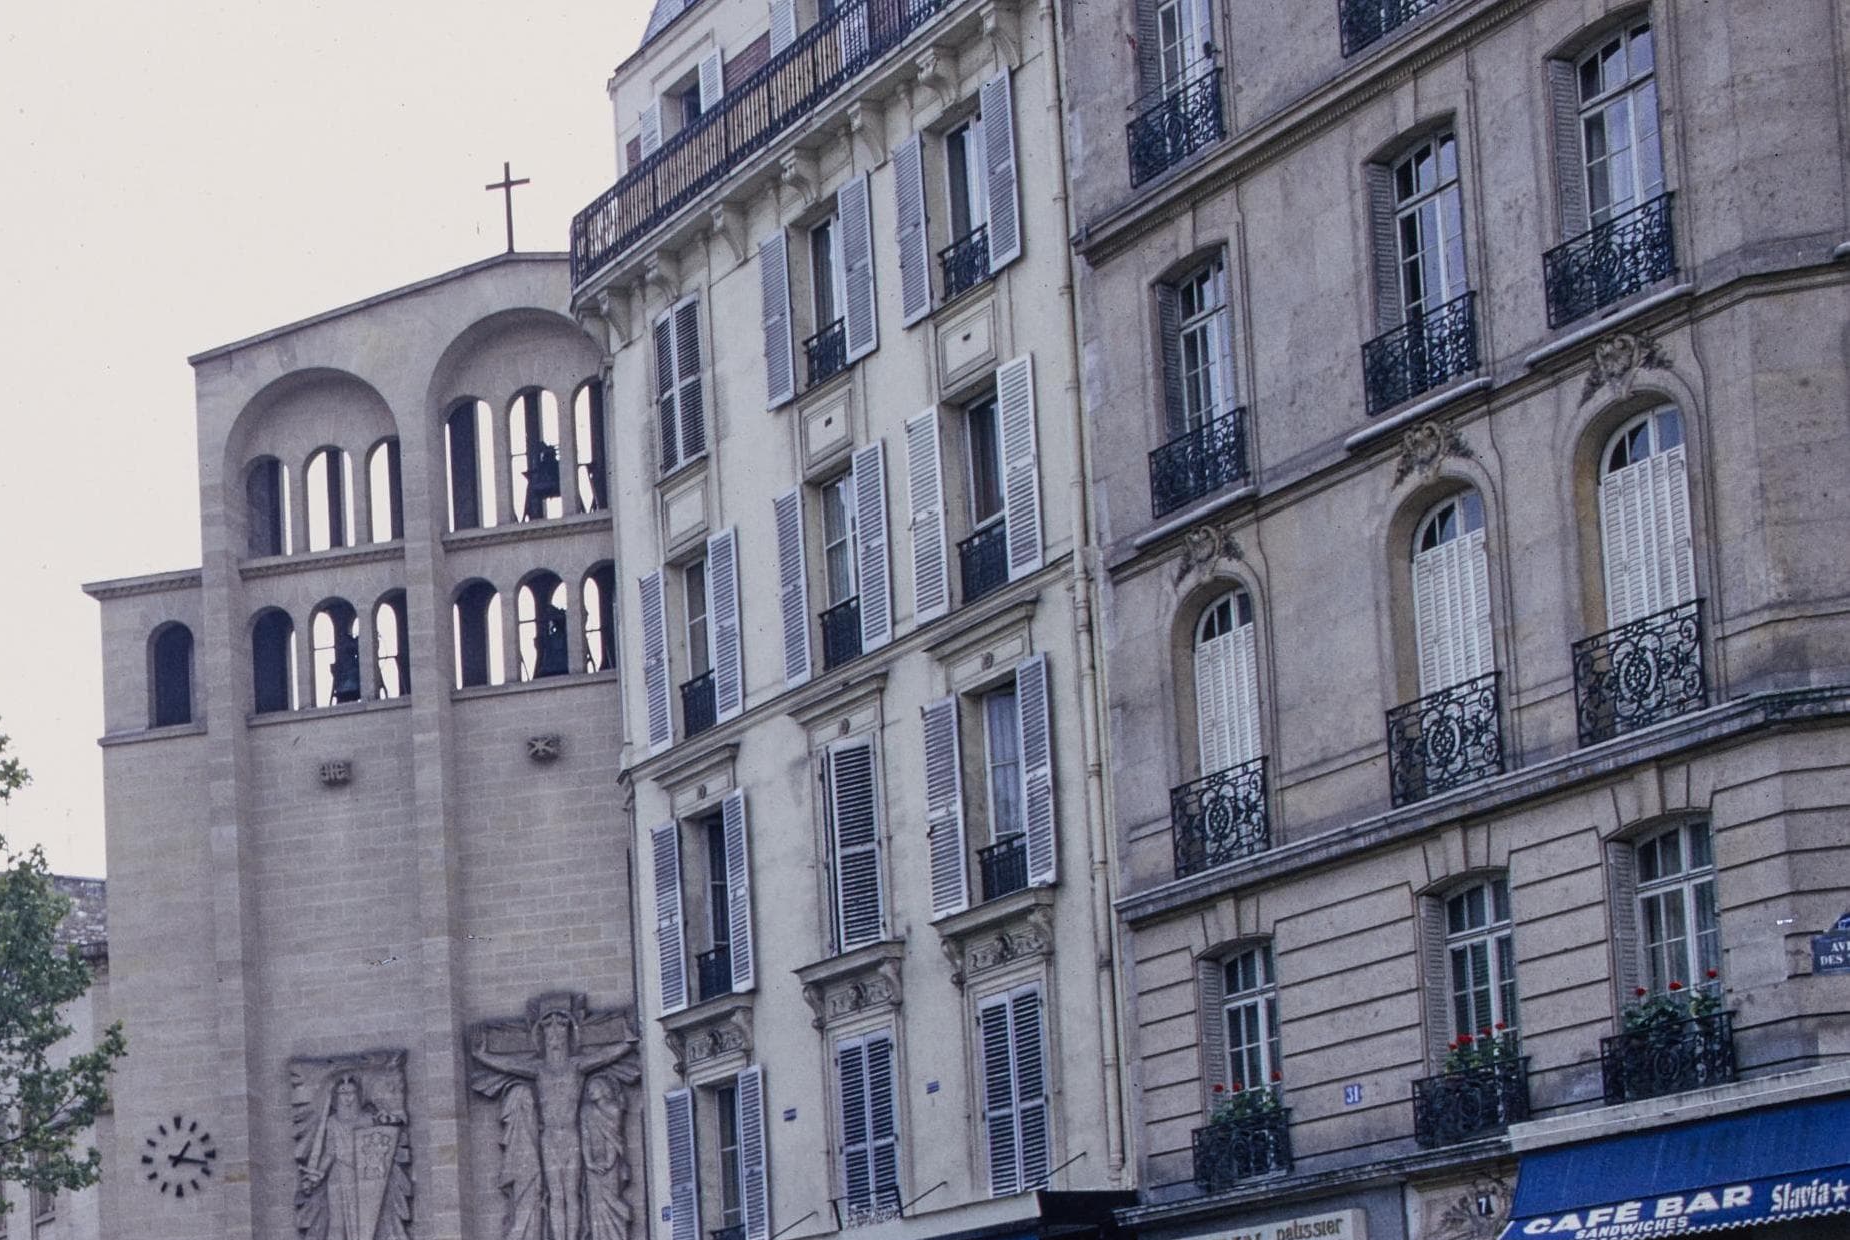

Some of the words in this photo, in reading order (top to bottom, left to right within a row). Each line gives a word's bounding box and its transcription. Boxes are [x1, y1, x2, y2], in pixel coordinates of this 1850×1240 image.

[1477, 1197, 1488, 1214] 7
[1523, 1201, 1643, 1235] CAFÉ
[1655, 1185, 1754, 1217] BAR
[1771, 1179, 1831, 1212] Slavia
[1575, 1215, 1690, 1240] SANDWICHES
